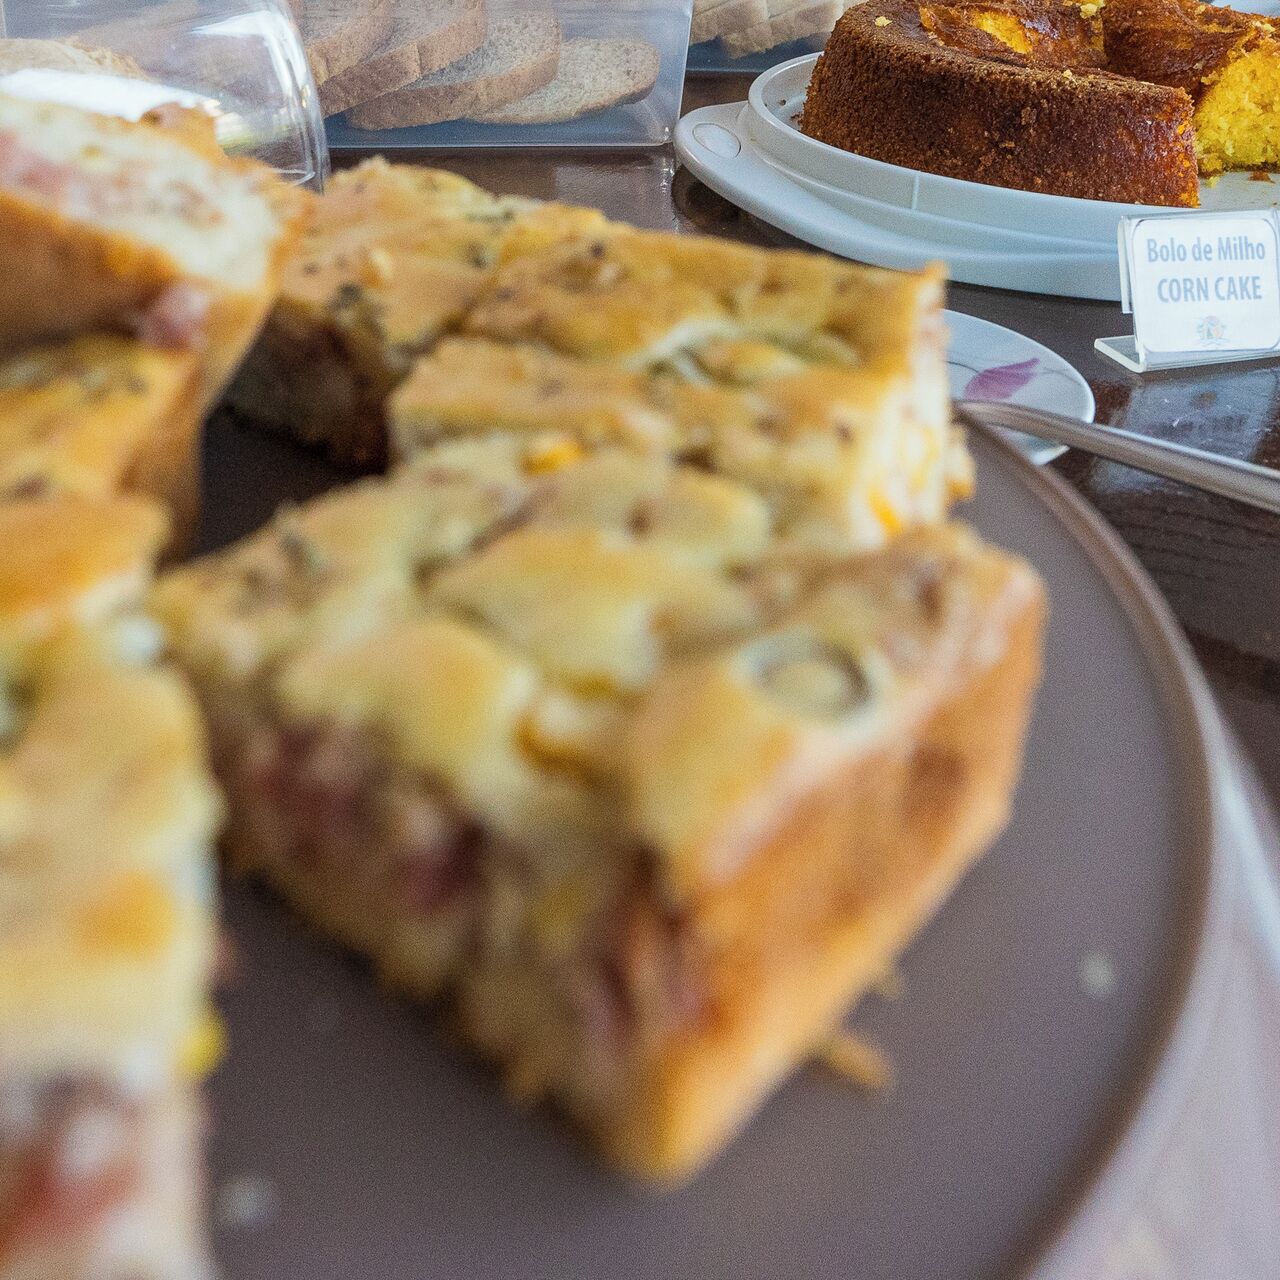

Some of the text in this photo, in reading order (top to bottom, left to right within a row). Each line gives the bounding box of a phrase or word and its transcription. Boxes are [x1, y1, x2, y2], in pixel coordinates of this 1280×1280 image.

[1146, 235, 1266, 262] Bolo de Milho
[1157, 275, 1263, 303] CORN CAKE
